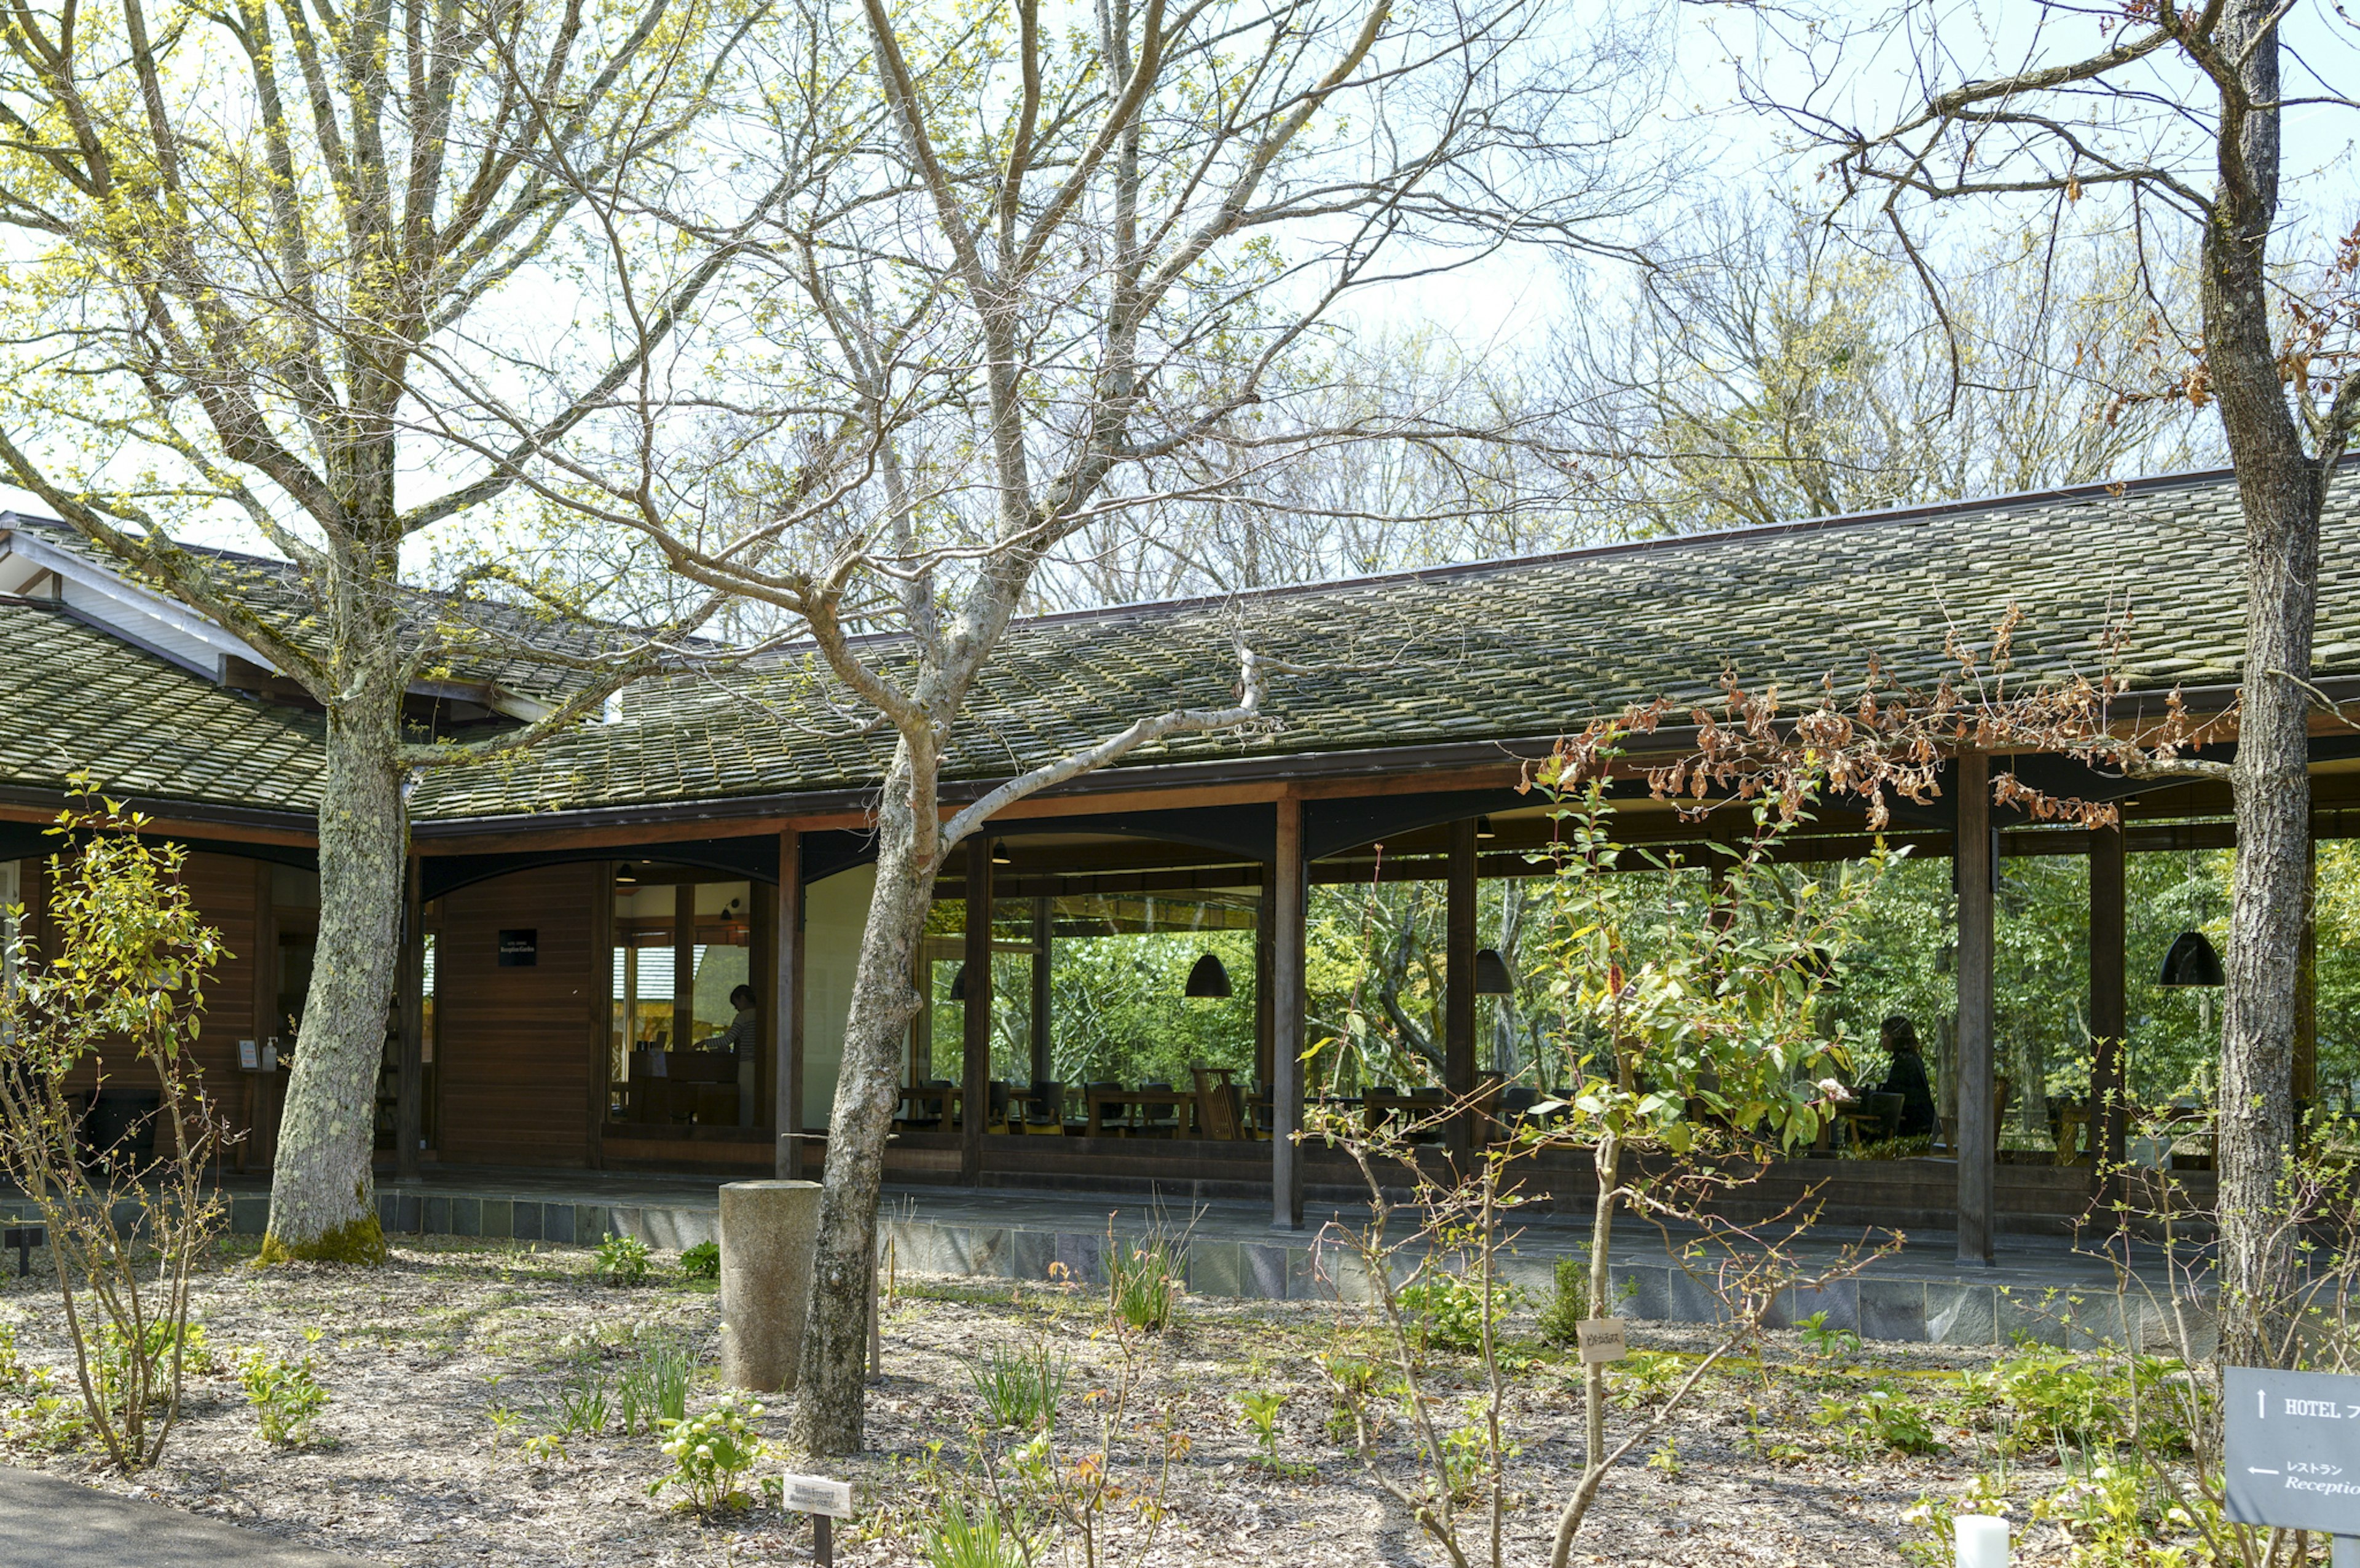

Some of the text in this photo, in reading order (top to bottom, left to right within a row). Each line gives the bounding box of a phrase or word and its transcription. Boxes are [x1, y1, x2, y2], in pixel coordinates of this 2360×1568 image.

[2284, 1398, 2341, 1419] HOTEL
[2287, 1460, 2342, 1475] レストラン
